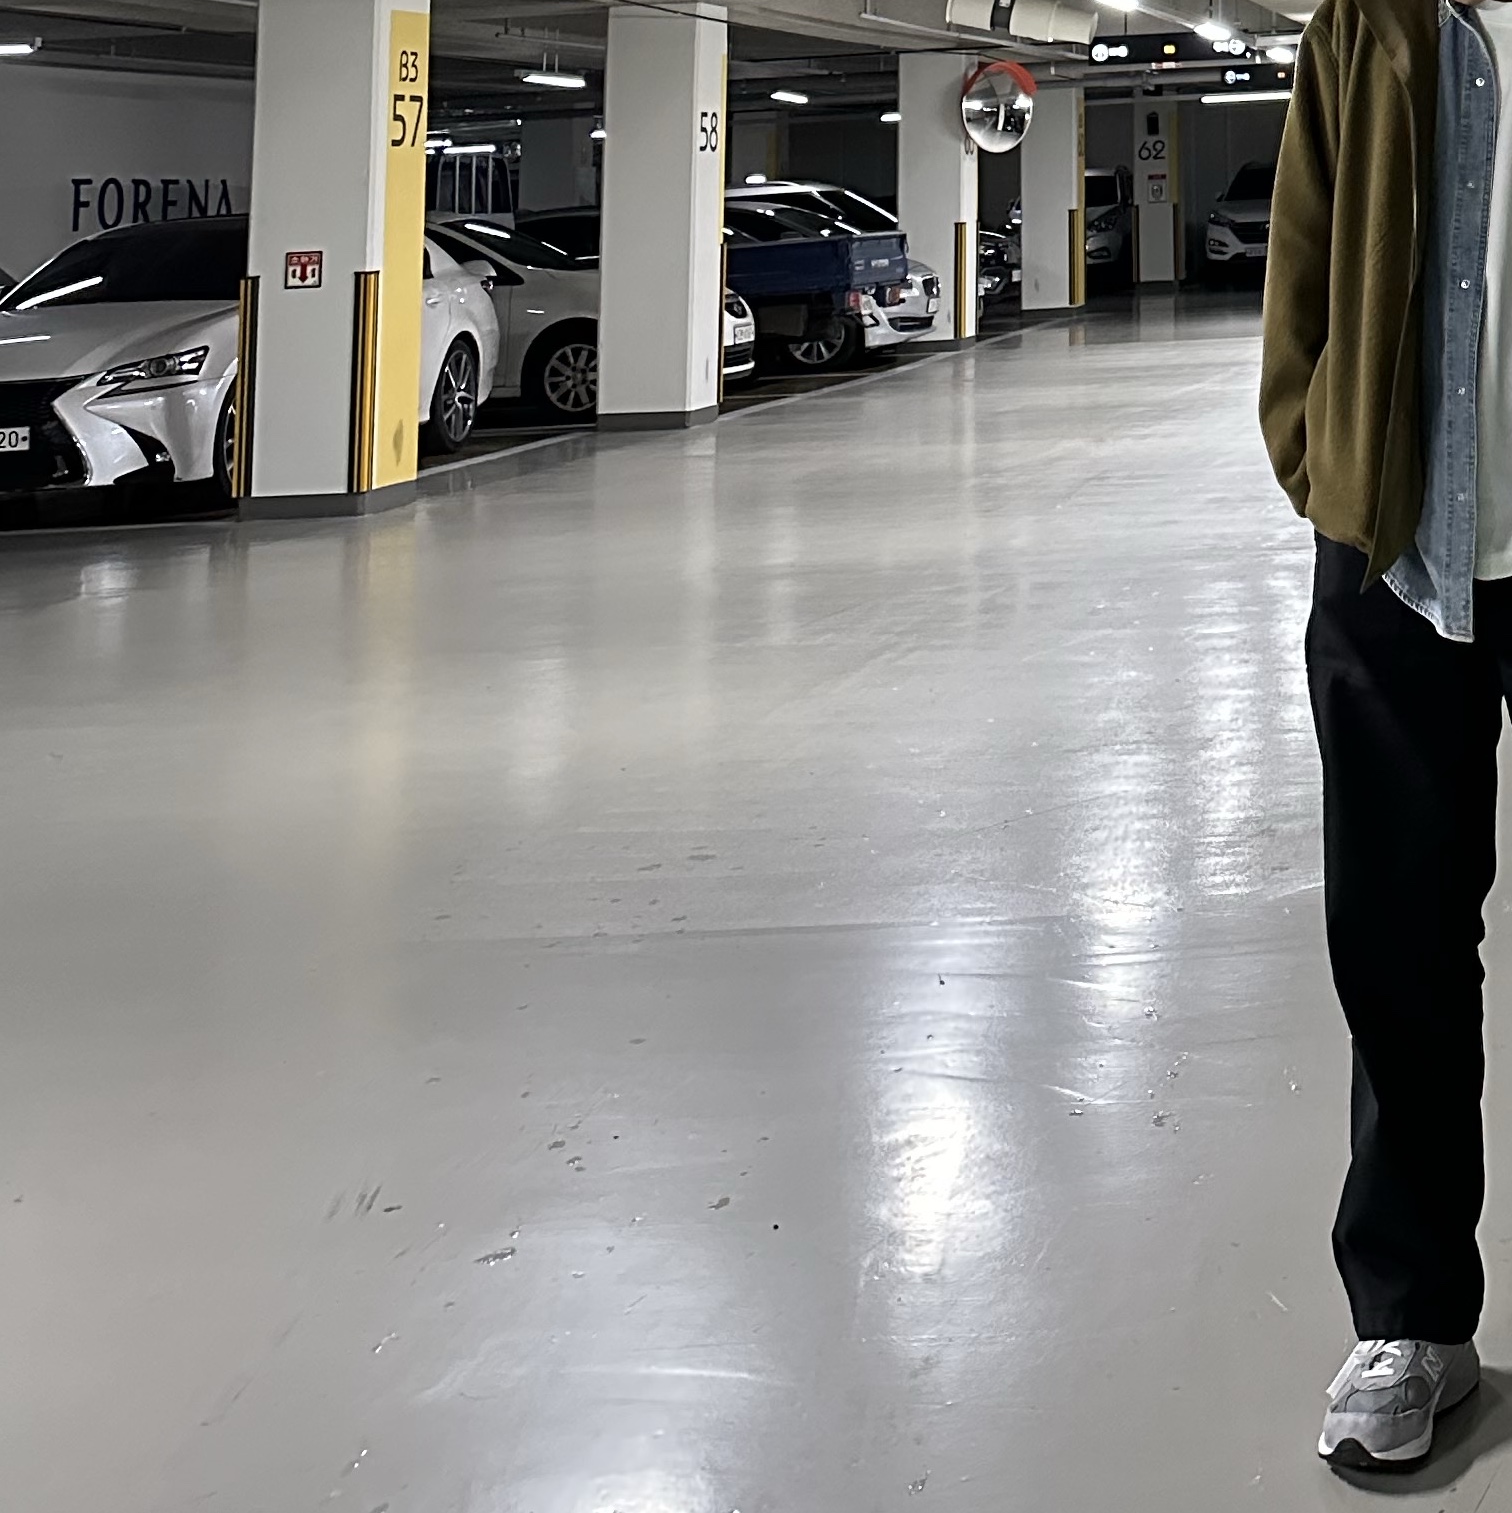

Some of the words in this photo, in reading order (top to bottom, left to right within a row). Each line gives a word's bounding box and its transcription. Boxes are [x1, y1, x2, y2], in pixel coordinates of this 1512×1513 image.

[399, 50, 419, 83] B3
[391, 94, 424, 147] 57
[699, 111, 719, 153] 58
[1138, 139, 1166, 161] 62
